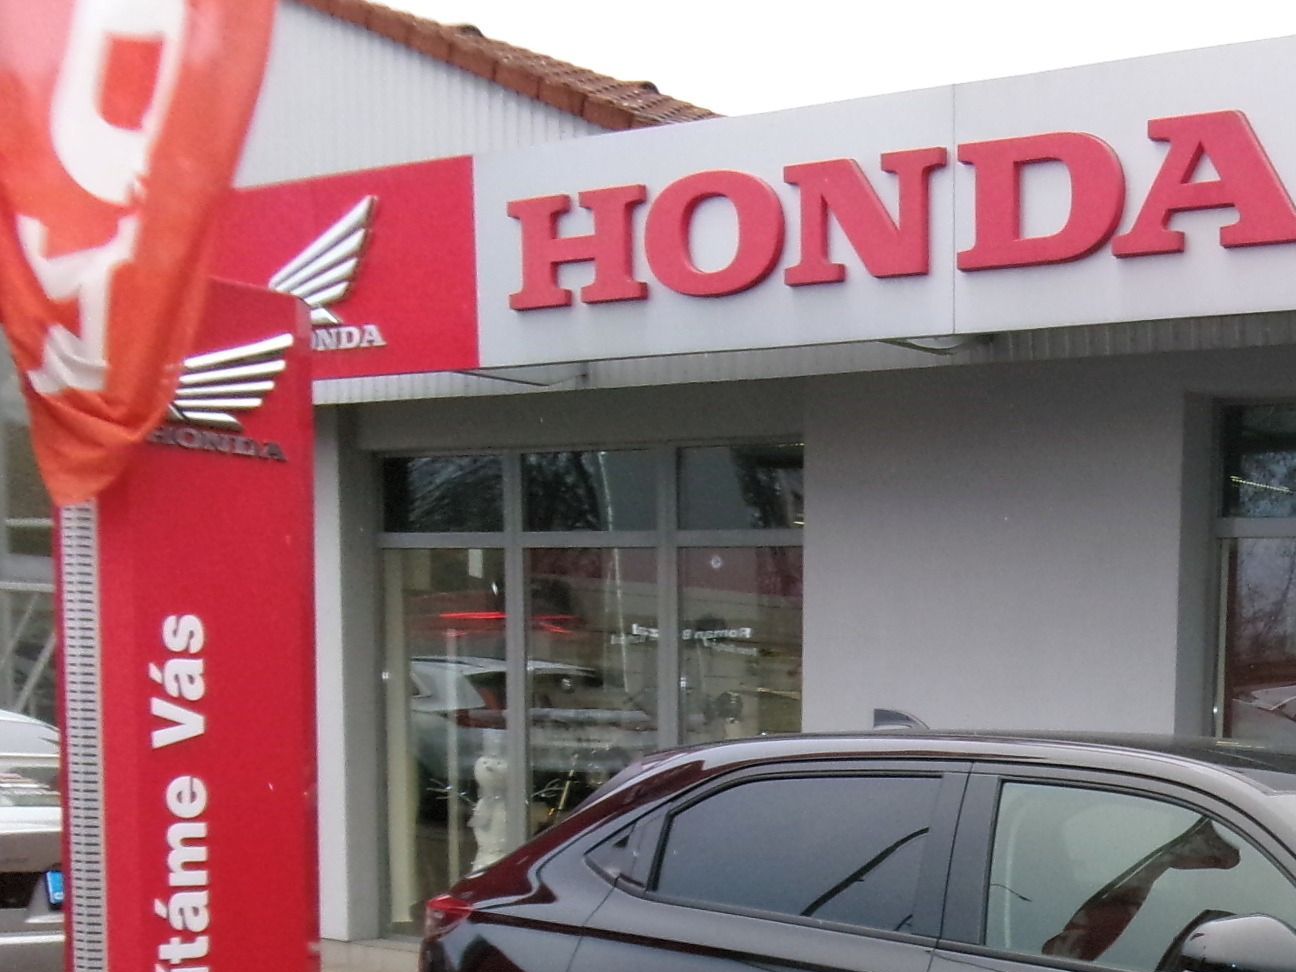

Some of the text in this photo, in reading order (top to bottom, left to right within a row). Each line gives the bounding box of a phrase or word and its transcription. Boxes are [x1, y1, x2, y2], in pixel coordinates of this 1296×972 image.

[311, 324, 387, 350] NDA
[148, 424, 289, 462] HONDA
[148, 613, 206, 750] Vás
